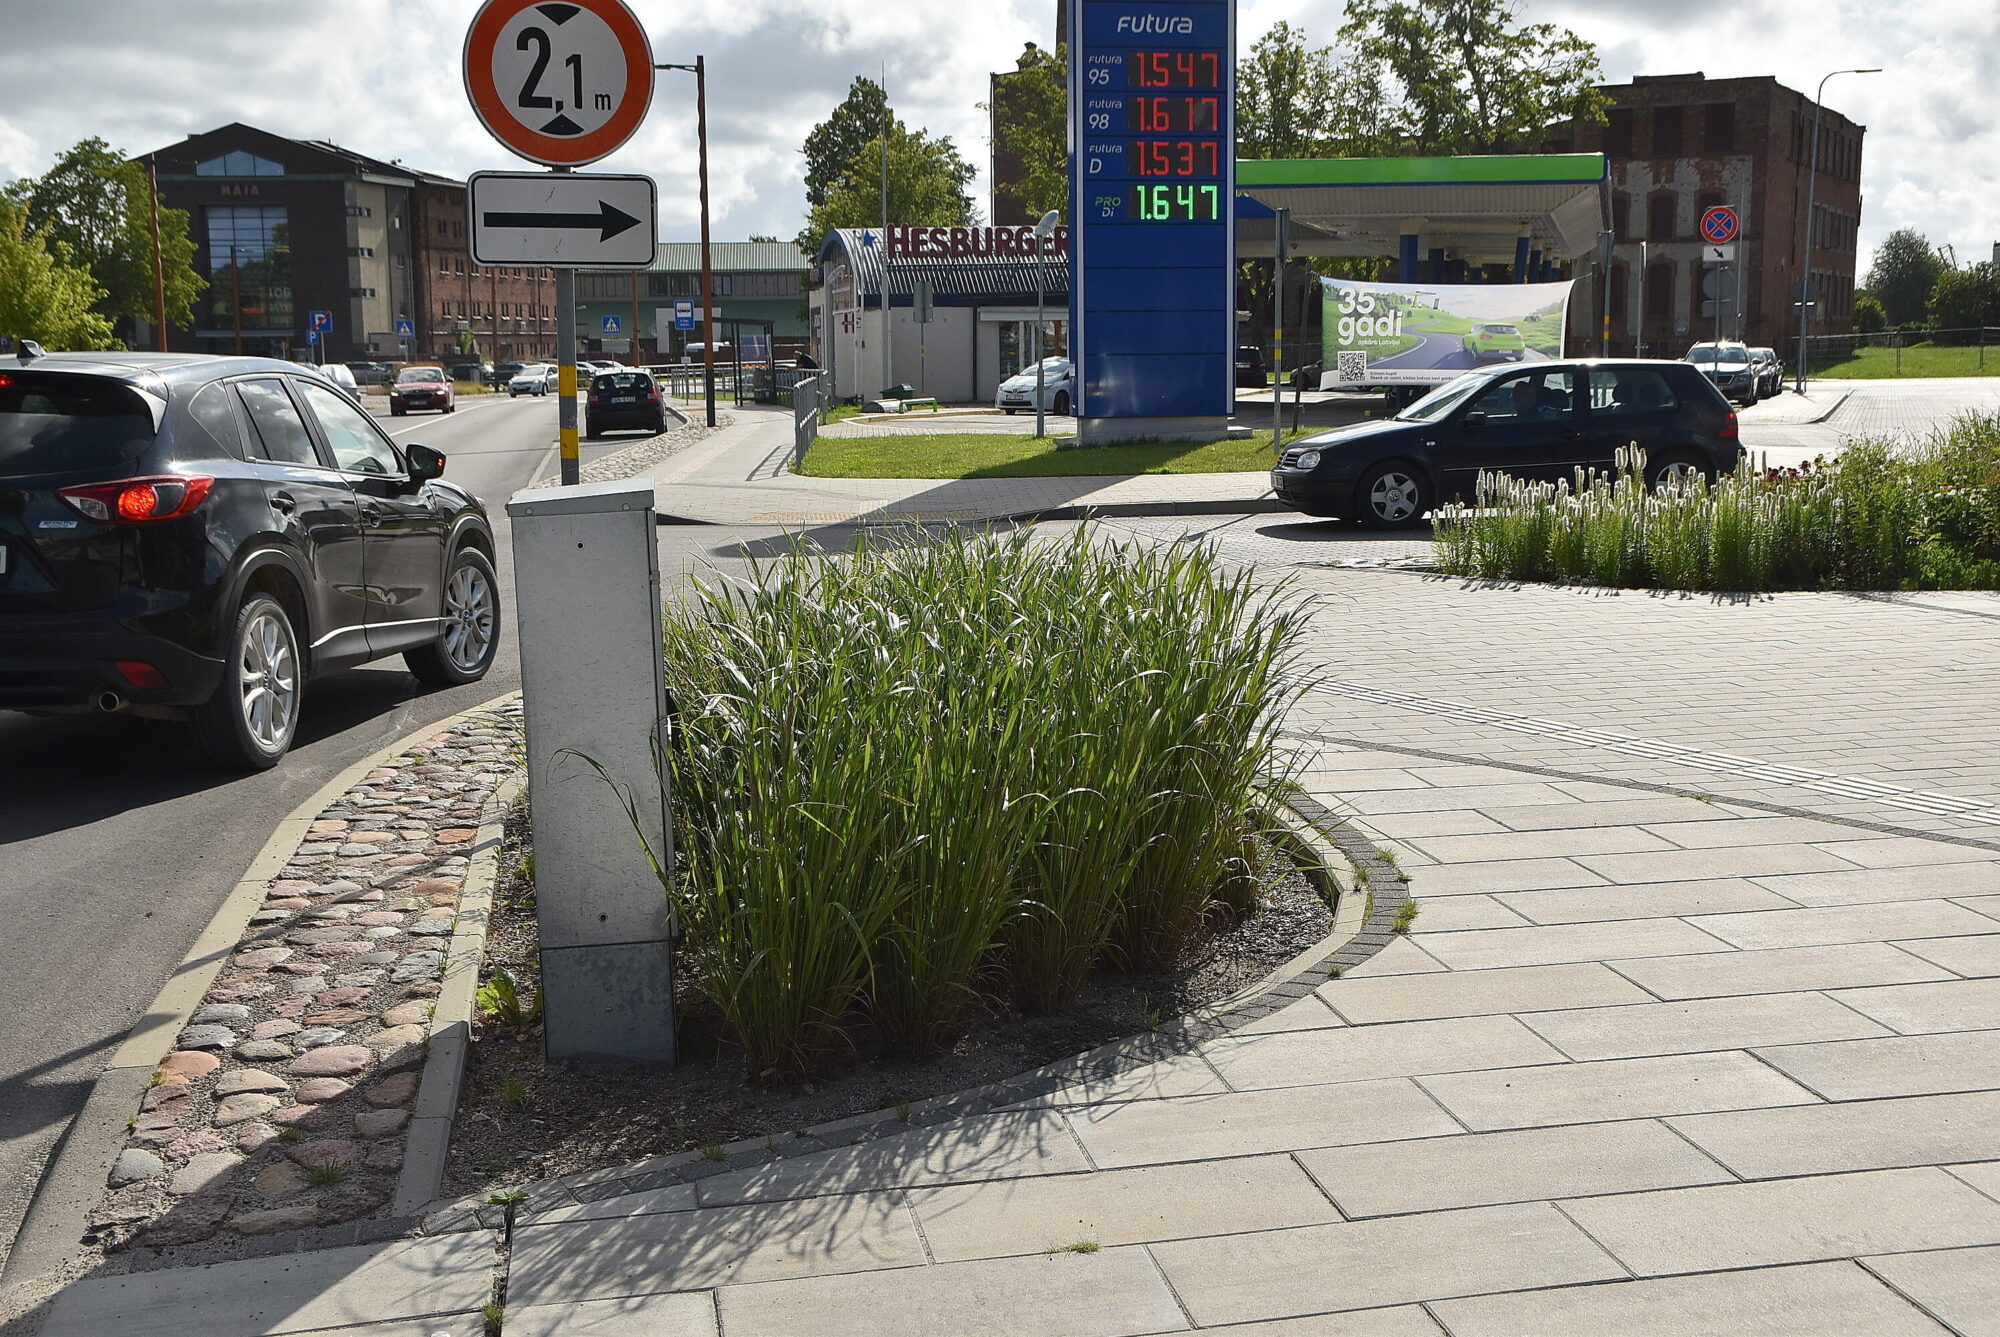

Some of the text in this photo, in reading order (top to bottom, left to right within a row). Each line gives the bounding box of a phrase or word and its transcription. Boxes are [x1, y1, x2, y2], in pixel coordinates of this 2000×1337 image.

[516, 26, 612, 114] 2,1 m
[1088, 69, 1110, 85] 95
[1136, 52, 1218, 88] 1.547
[1088, 114, 1110, 130] 98
[1136, 97, 1218, 132] 1.617
[1089, 159, 1102, 174] D
[1136, 141, 1218, 176] 1.537
[1095, 197, 1122, 207] PRO
[1102, 207, 1115, 217] Di
[1136, 185, 1218, 220] 1.647
[1338, 287, 1376, 314] 35
[1338, 309, 1403, 345] gadi
